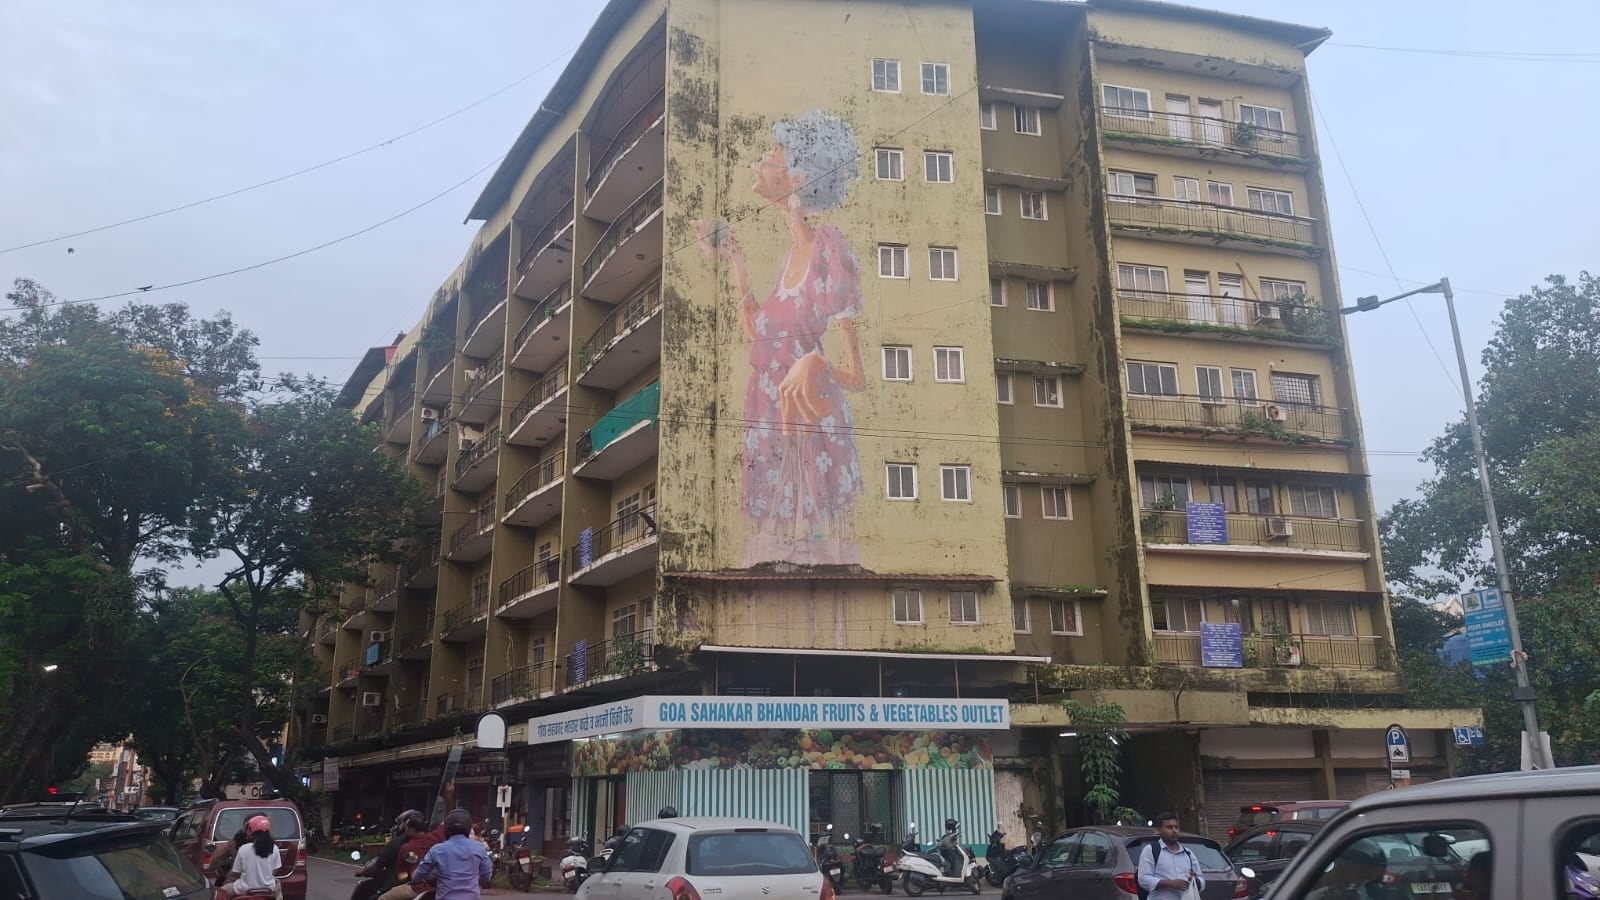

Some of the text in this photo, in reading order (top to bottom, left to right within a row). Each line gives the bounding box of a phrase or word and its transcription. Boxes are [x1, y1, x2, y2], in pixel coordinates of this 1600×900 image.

[659, 702, 1004, 724] GOA SAHAKAR BHANDAR FRUITS & VEGETABLES OUTLET
[590, 715, 594, 730] व
[1391, 731, 1400, 744] P
